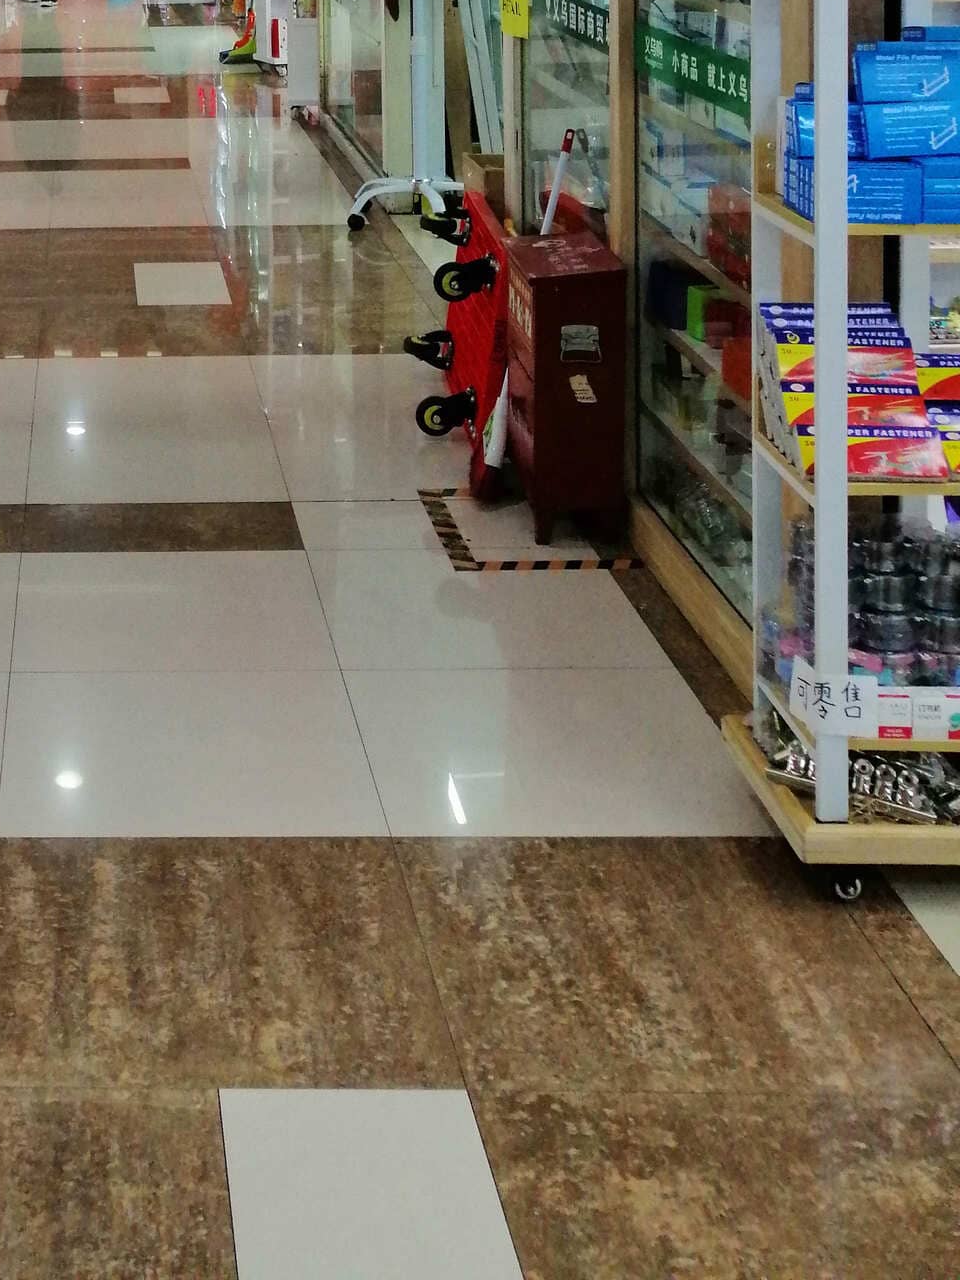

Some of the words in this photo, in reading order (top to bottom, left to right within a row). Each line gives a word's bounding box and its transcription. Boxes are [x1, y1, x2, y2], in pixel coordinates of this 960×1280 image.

[672, 49, 699, 82] 小商品
[707, 62, 749, 103] 就上义乌
[856, 386, 912, 395] FASTENER
[873, 429, 933, 438] FASTENER
[796, 676, 862, 720] 可零售
